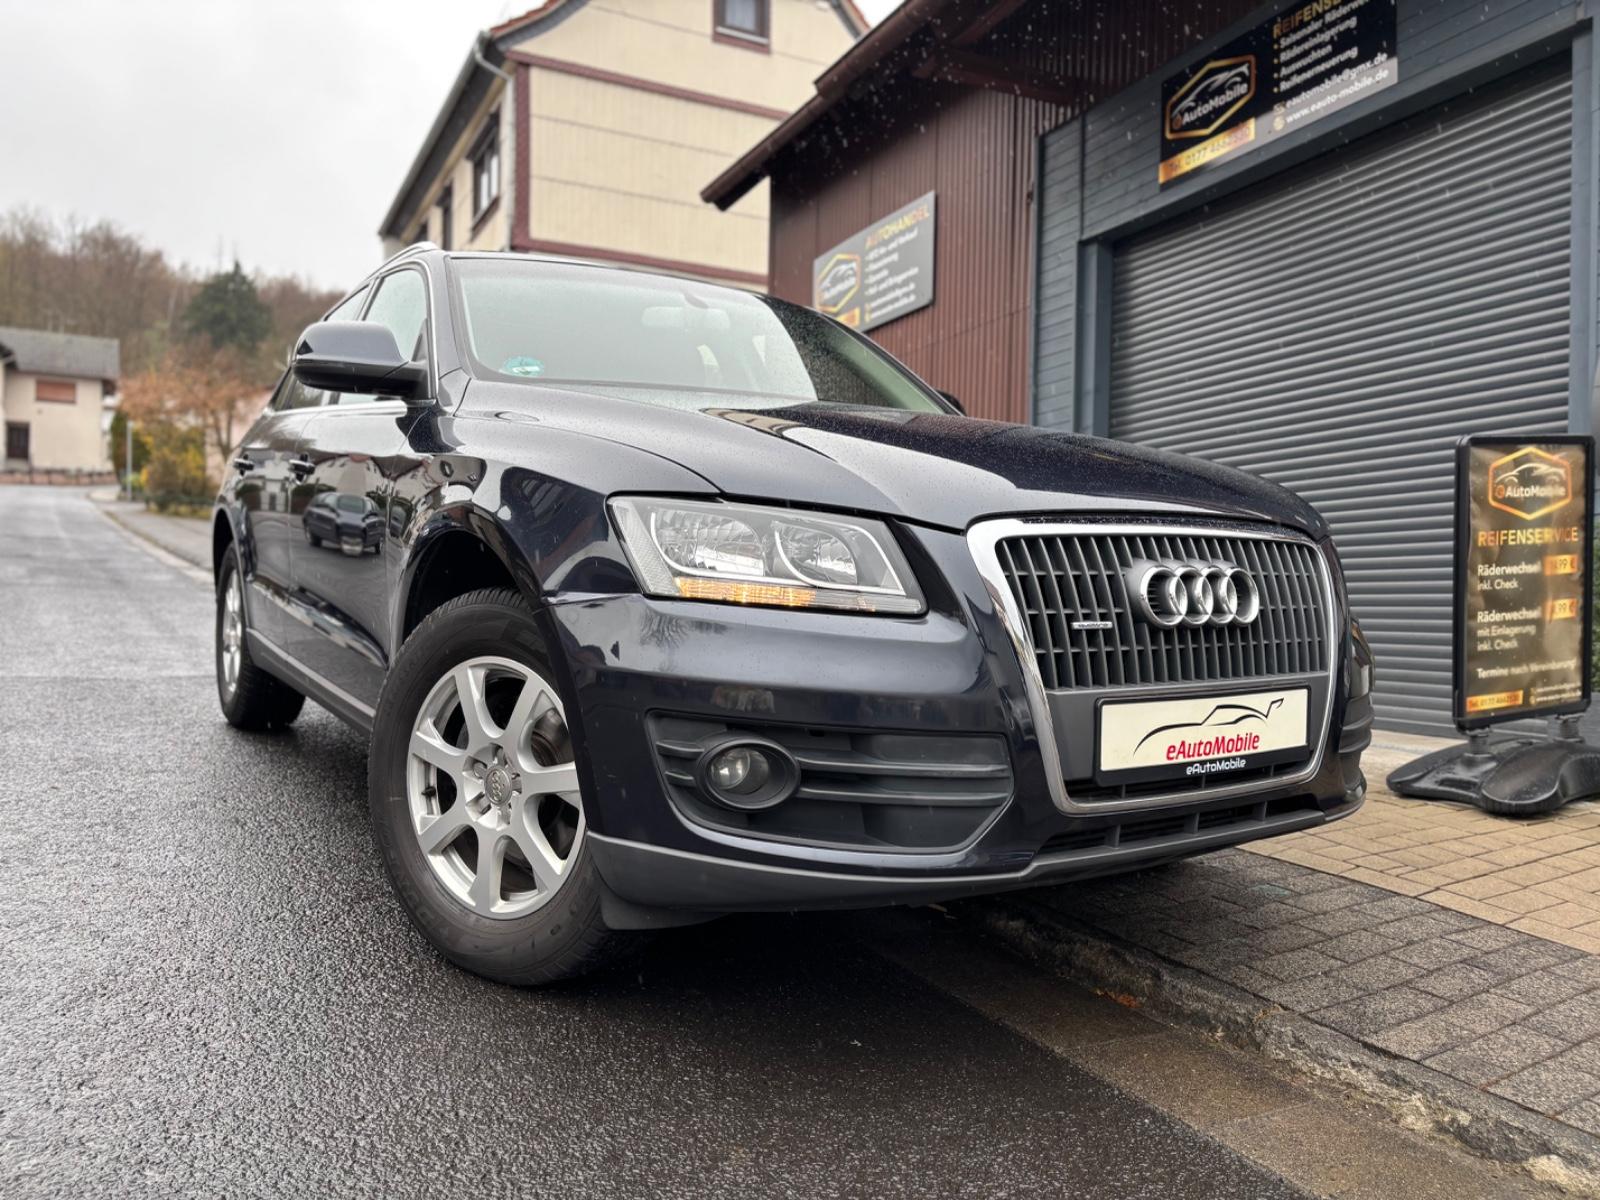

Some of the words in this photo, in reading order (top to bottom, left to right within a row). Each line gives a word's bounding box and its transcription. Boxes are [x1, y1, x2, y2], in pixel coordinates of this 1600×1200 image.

[1280, 44, 1332, 78] Auswuchten
[1477, 527, 1579, 547] REIFENSERVICE
[1477, 561, 1541, 576] Räderwechsel
[1494, 578, 1518, 590] Check
[1477, 606, 1541, 623] Räderwechsel
[1494, 638, 1518, 650] Check
[1476, 667, 1508, 679] Termine
[1166, 732, 1260, 761] eAutoMobile
[1186, 757, 1246, 775] eAutoMobile
